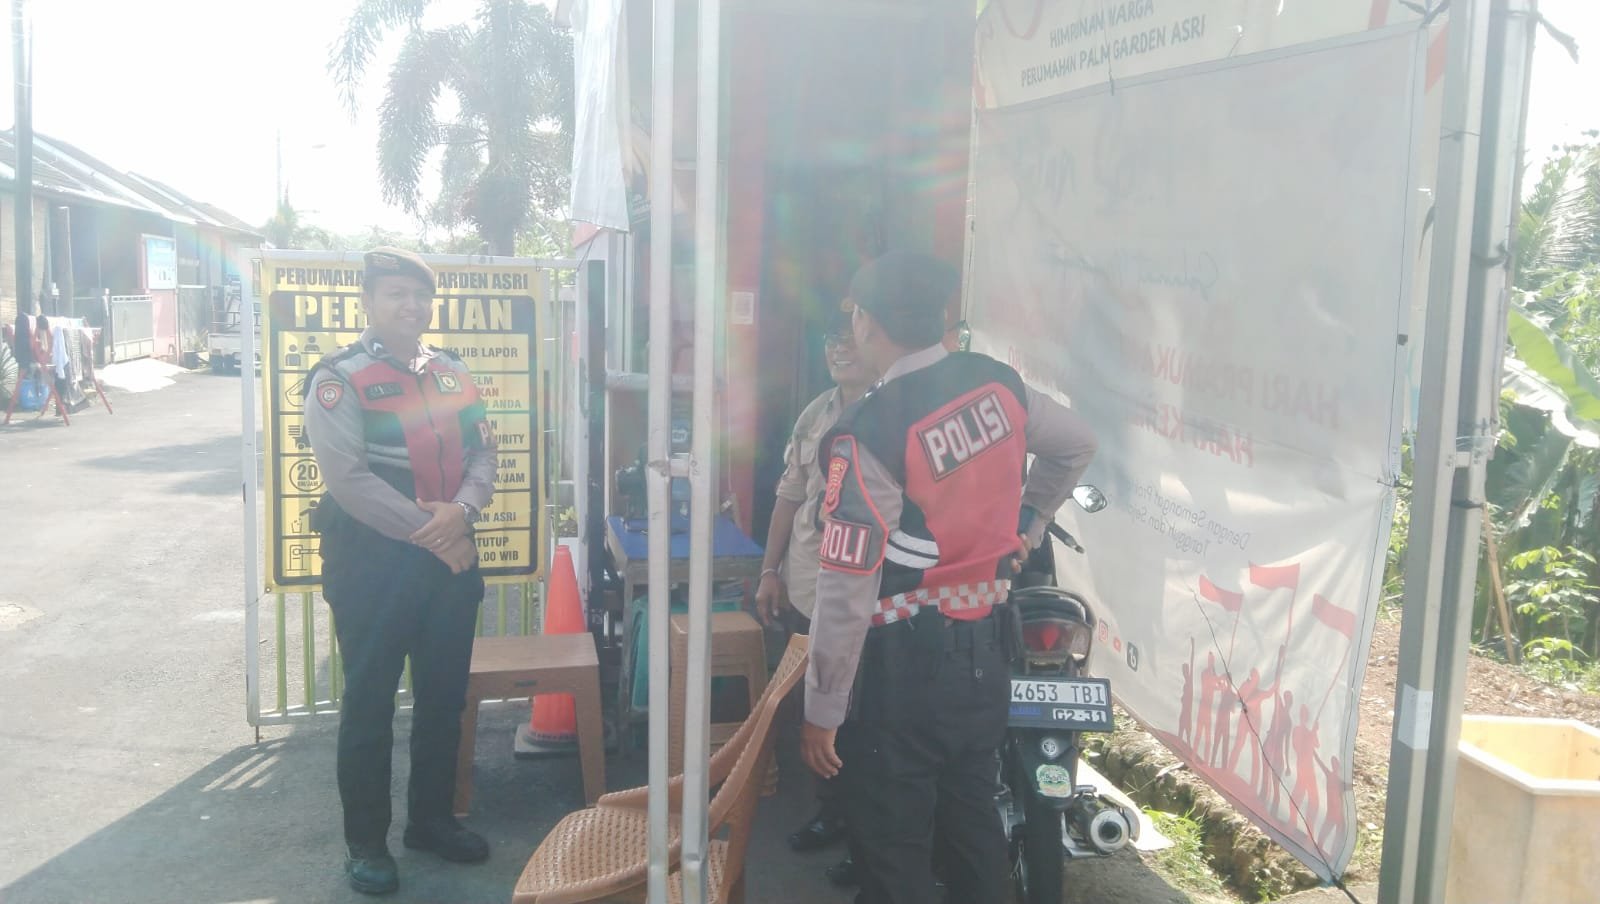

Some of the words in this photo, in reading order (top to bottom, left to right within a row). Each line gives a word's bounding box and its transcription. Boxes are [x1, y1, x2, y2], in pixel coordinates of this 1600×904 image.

[1080, 42, 1110, 70] PALM
[1113, 26, 1166, 59] GARDEN
[1171, 13, 1206, 45] ASRI
[275, 267, 363, 287] PERUMAHA
[438, 272, 488, 289] ARDEN
[492, 273, 528, 289] ASRI
[295, 295, 512, 330] PERTIAN
[482, 347, 518, 358] LAPOR
[473, 376, 493, 385] ELM
[493, 400, 521, 409] ANDA
[495, 434, 524, 444] URITY
[925, 394, 1011, 473] POLISI
[297, 464, 318, 480] 20
[493, 512, 516, 521] ASRI
[477, 537, 508, 547] TUTUP
[820, 522, 866, 564] ROLI
[500, 551, 518, 561] WIB
[1013, 683, 1058, 702] 4653
[1071, 686, 1105, 704] TBI
